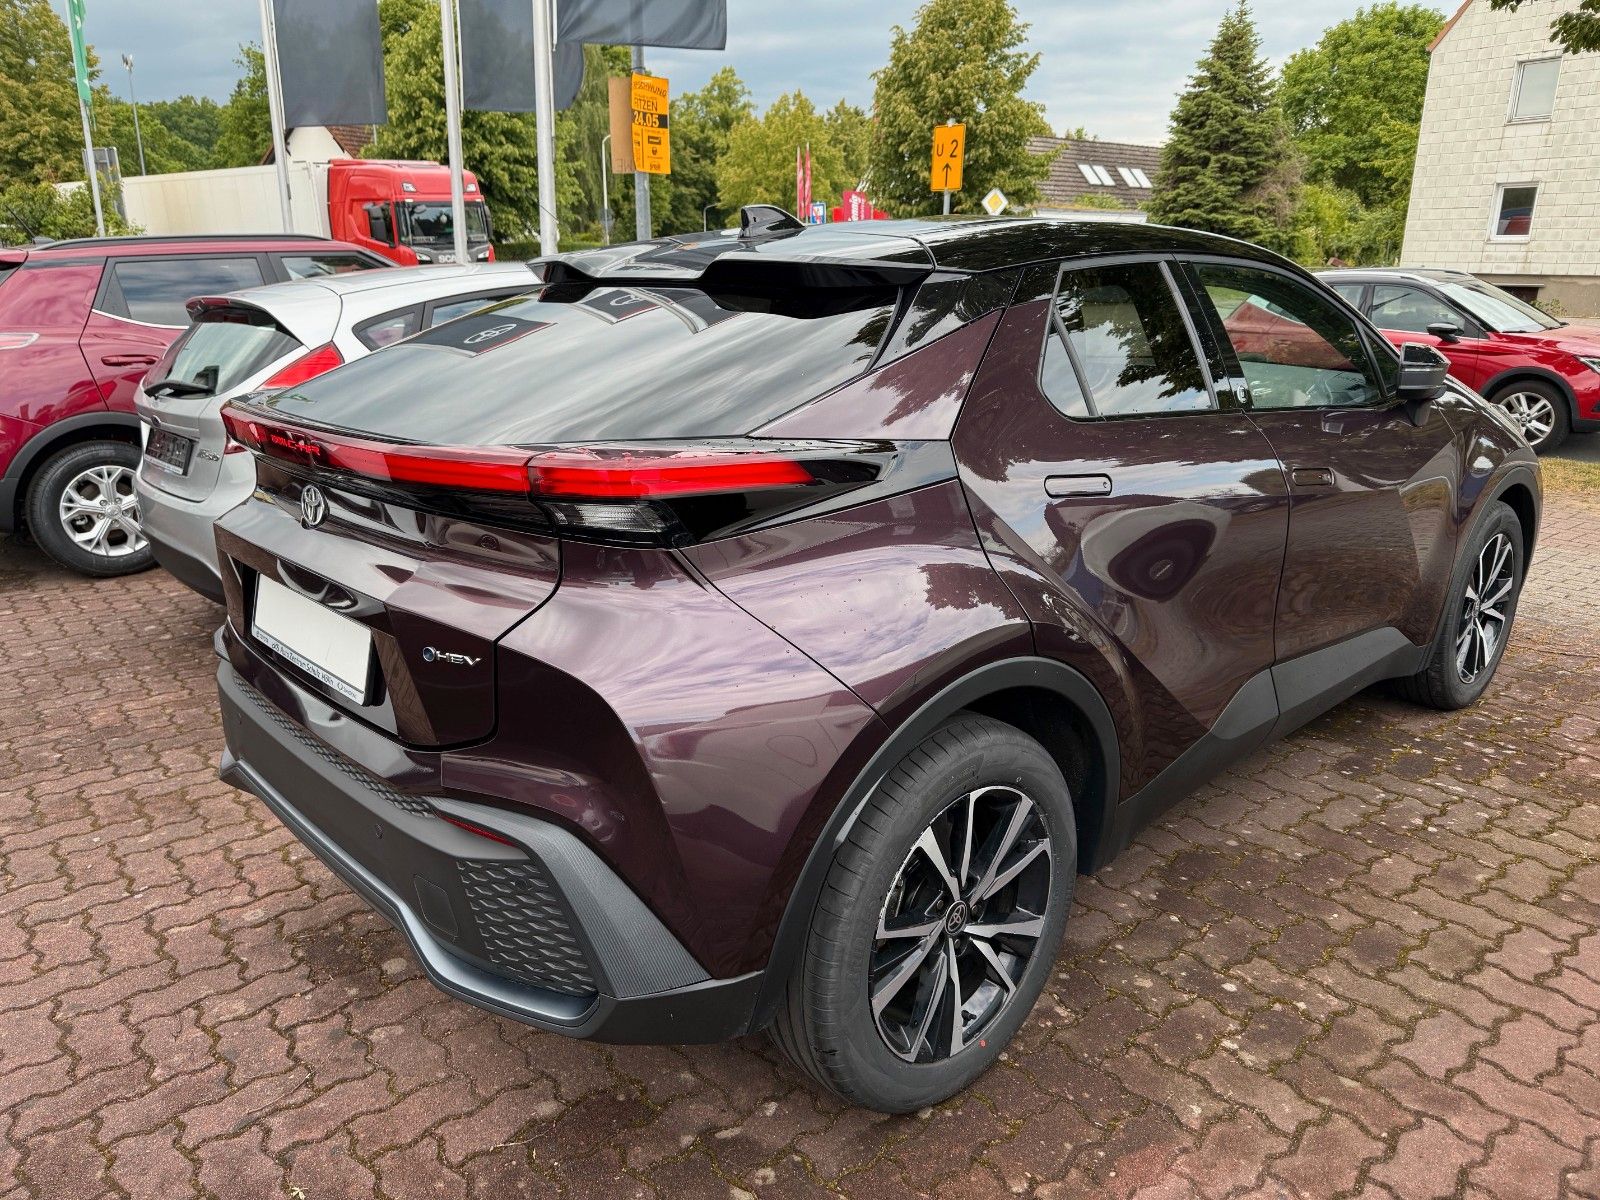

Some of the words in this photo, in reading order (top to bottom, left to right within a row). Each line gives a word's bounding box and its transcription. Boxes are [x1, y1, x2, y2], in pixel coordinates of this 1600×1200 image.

[936, 144, 944, 157] U
[950, 139, 959, 158] 2
[436, 651, 481, 665] HEV
